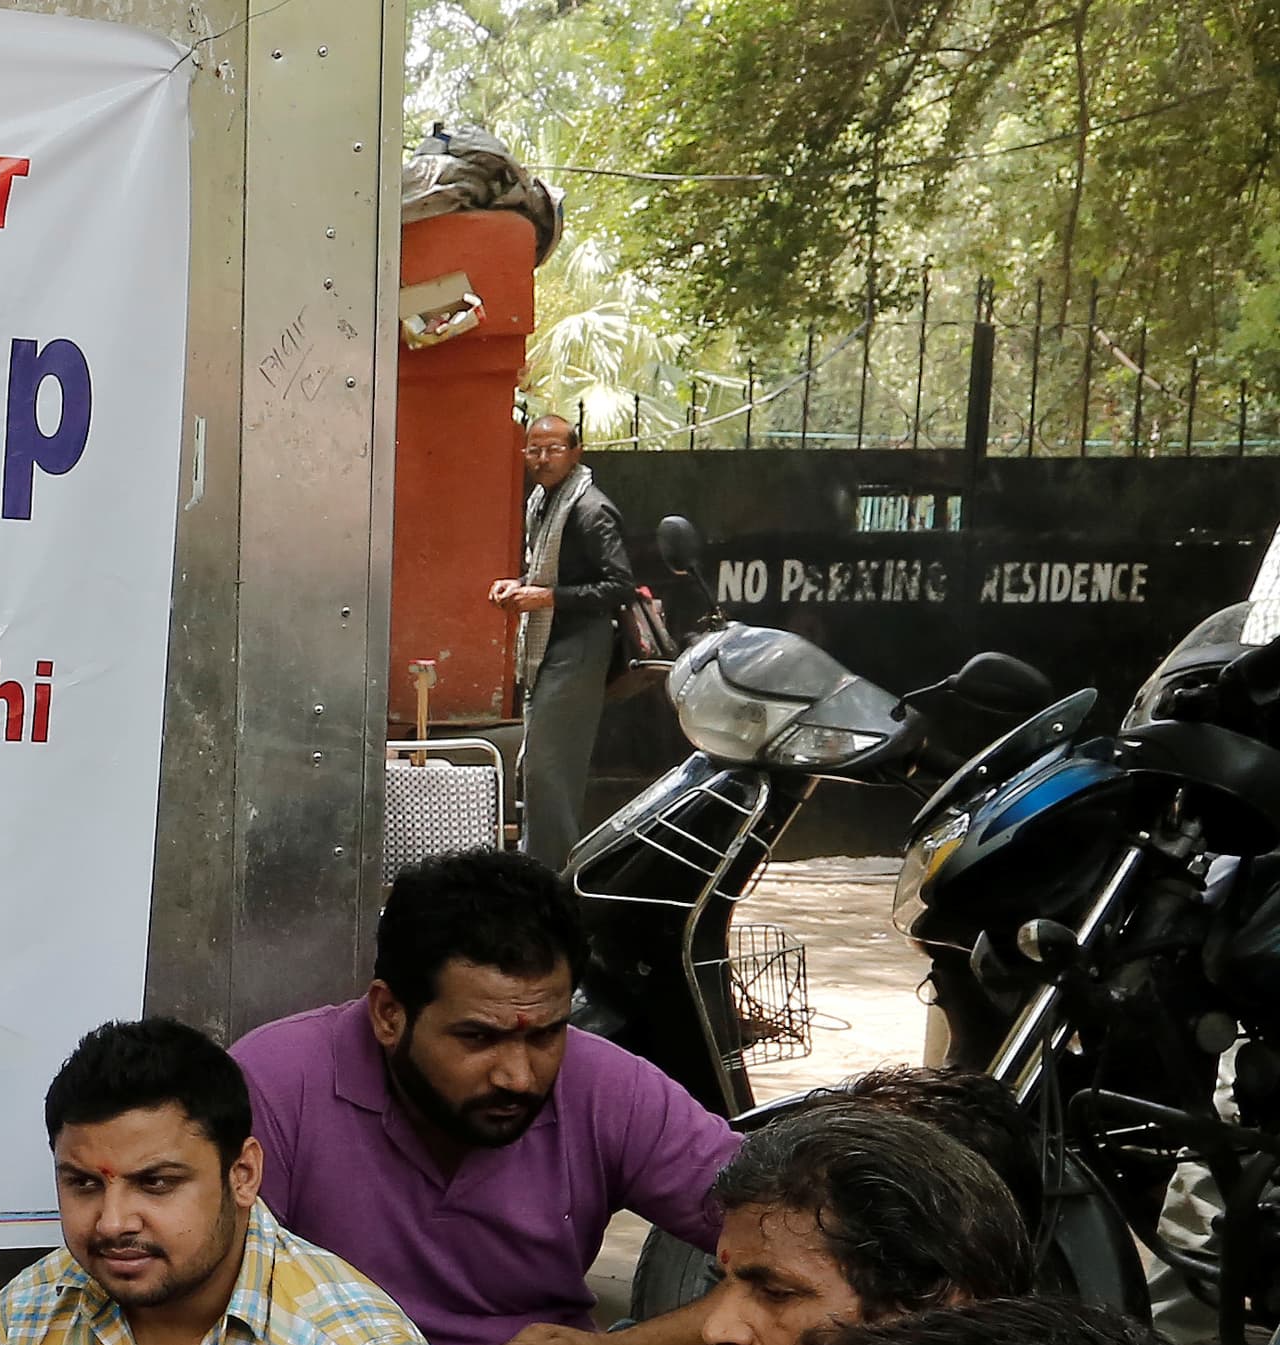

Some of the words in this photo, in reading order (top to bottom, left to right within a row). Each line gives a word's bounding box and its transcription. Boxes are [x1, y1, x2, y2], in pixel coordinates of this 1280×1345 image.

[717, 559, 768, 604] NO
[781, 559, 948, 603] PARKING
[980, 561, 1150, 604] RESIDENCE
